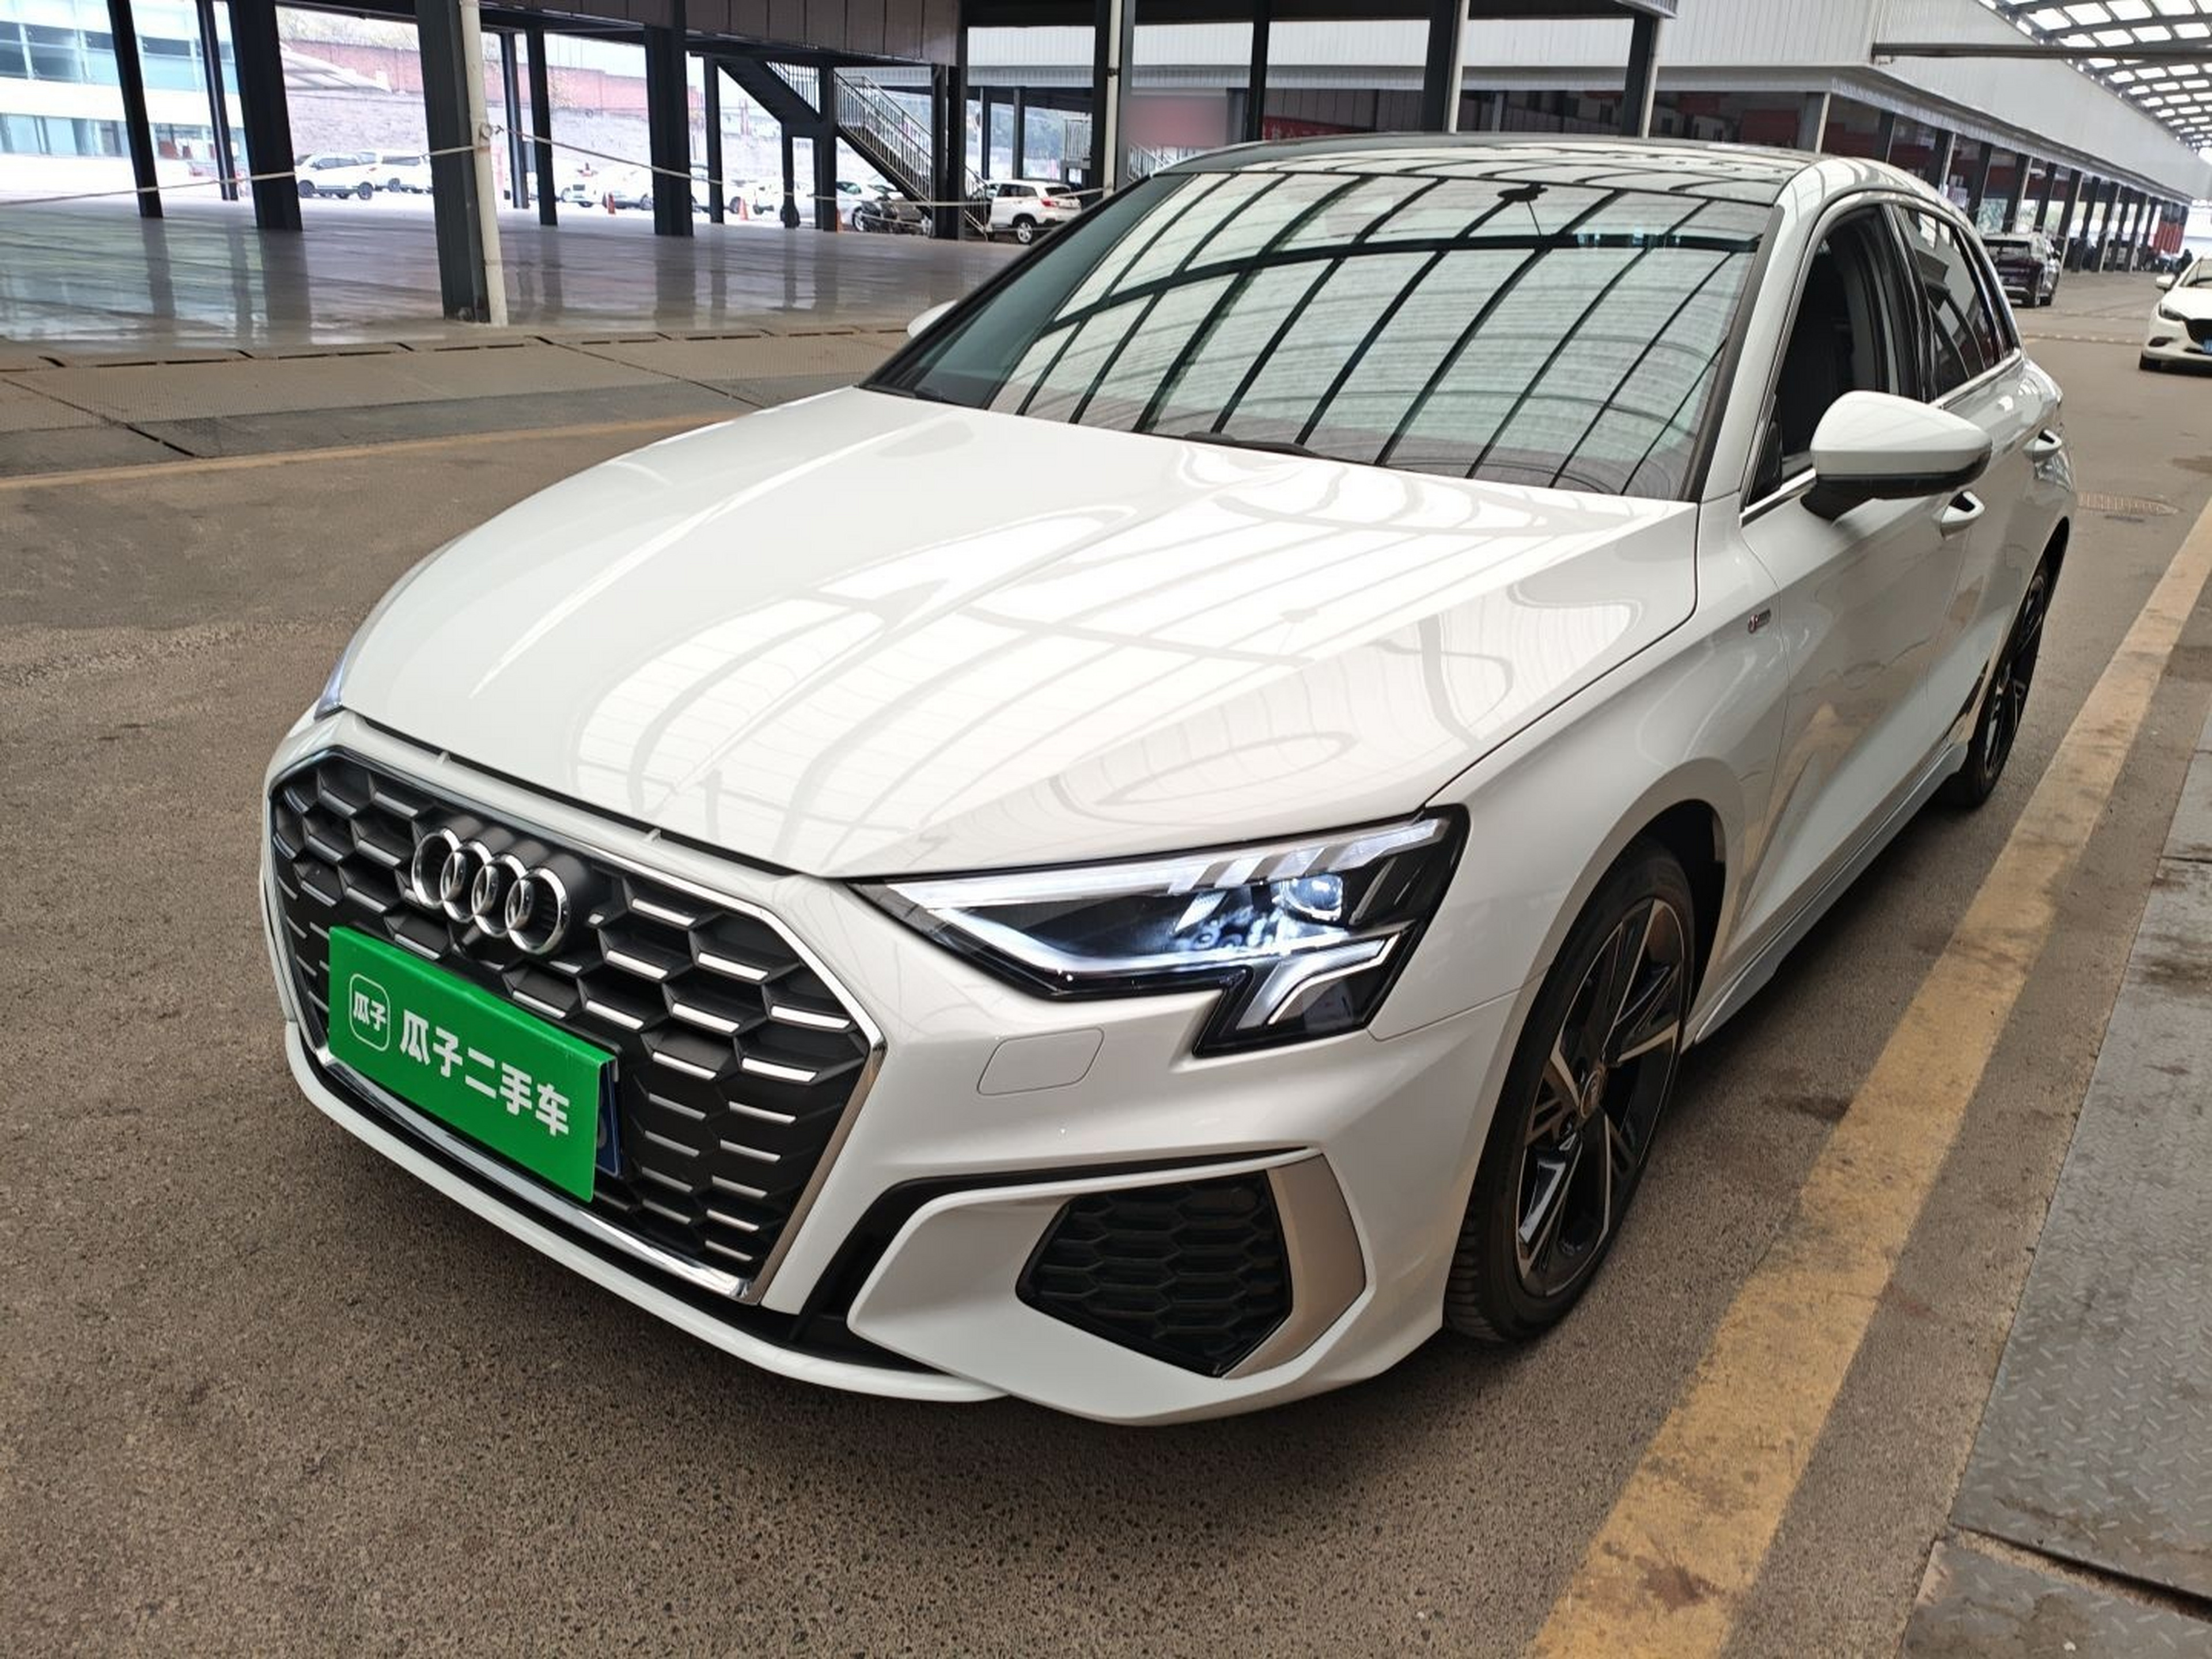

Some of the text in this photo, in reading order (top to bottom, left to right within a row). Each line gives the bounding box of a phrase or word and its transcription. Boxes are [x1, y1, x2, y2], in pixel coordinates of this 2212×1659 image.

[353, 991, 386, 1031] 瓜子
[400, 1009, 569, 1137] 瓜子二手车
